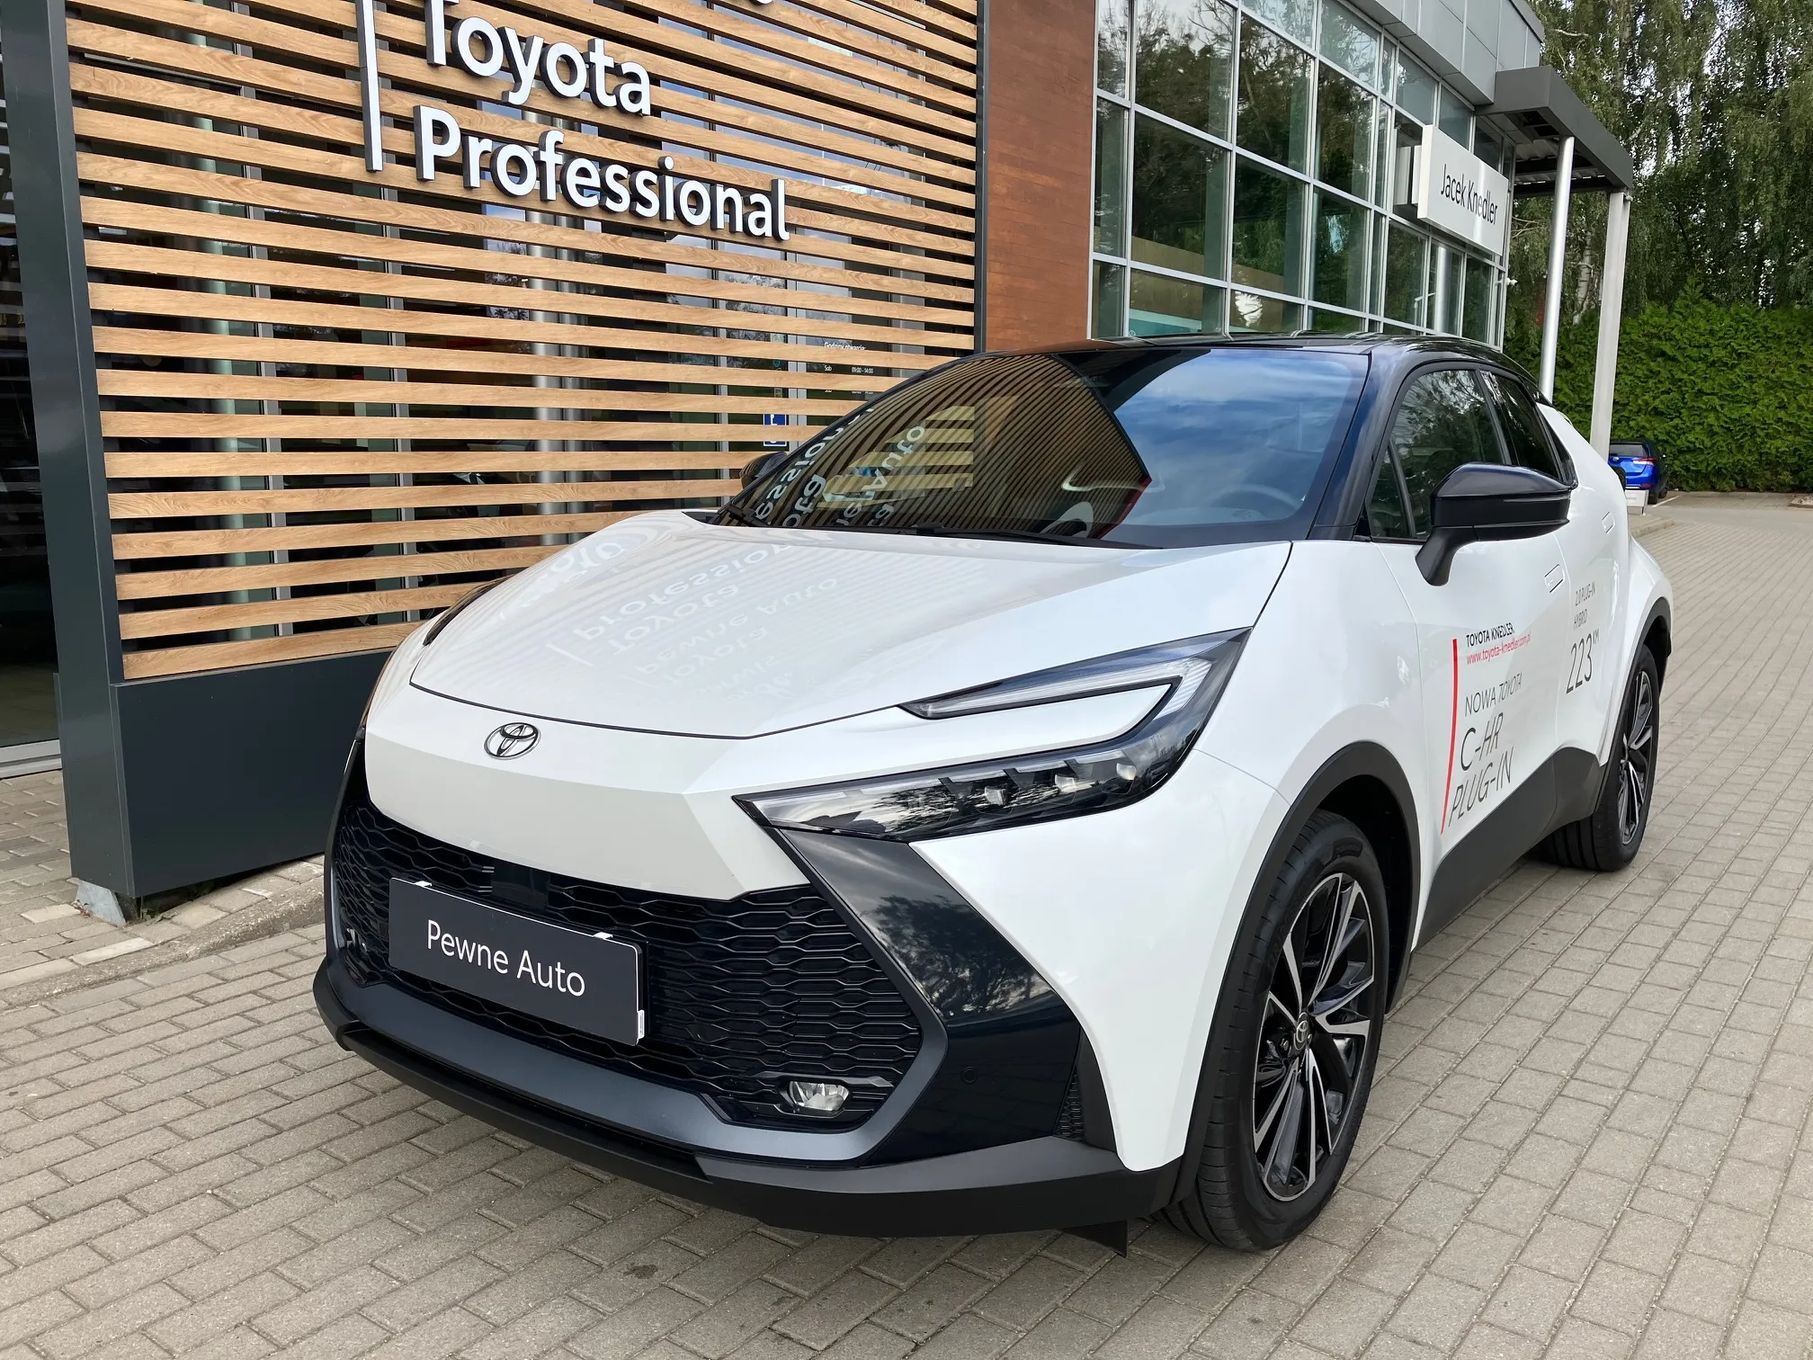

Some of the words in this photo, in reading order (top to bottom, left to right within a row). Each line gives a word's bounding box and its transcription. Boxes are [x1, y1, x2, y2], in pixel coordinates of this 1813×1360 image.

[424, 0, 652, 117] Toyota
[414, 104, 790, 242] Professional
[1440, 163, 1466, 208] Jacek
[1467, 180, 1498, 225] Knedler
[1465, 629, 1491, 648] TOYOTA
[1490, 622, 1516, 640] KNEDLER
[1565, 633, 1593, 695] 223
[1464, 688, 1497, 717] NOWA
[1498, 671, 1523, 702] TOYOTA
[1460, 711, 1504, 772] C-HR
[1448, 746, 1515, 828] PLUG-IN
[427, 919, 509, 974] Pewne
[516, 949, 586, 997] Auto
